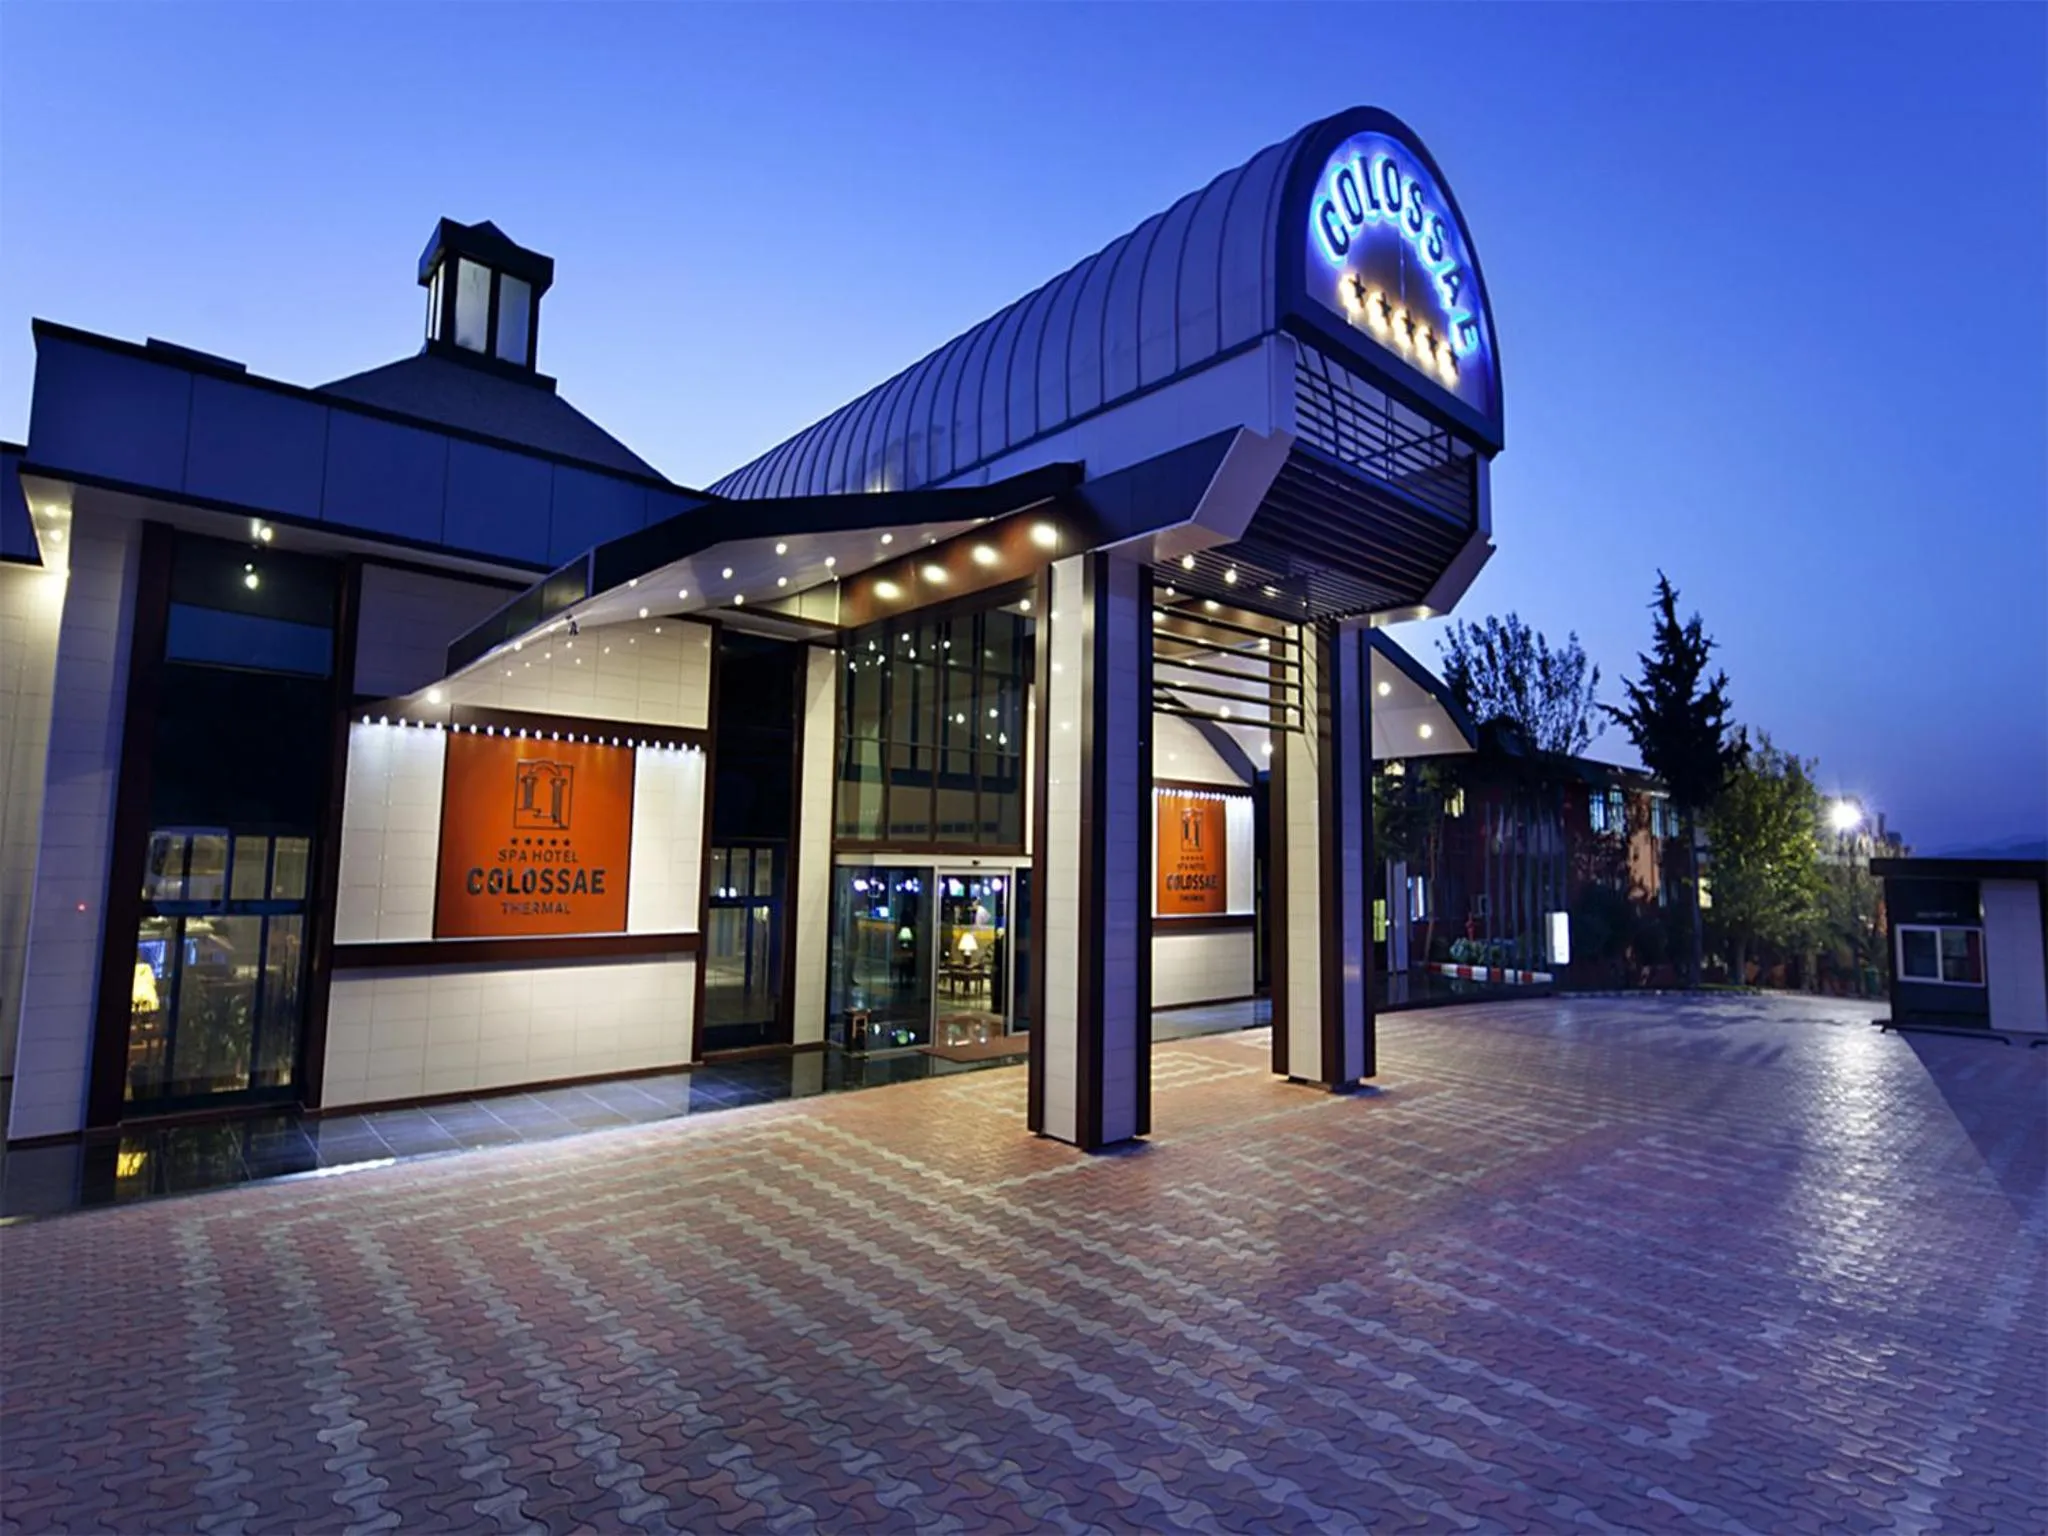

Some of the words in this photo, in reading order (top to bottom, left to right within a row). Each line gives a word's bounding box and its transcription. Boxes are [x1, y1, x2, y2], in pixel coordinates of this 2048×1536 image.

[1315, 153, 1480, 352] COLOSSAE
[497, 849, 528, 862] SPA
[532, 850, 579, 864] HOTEL
[466, 867, 606, 895] COLOSSAE
[1166, 873, 1218, 891] COLOSSAE
[501, 901, 571, 915] THERMAL
